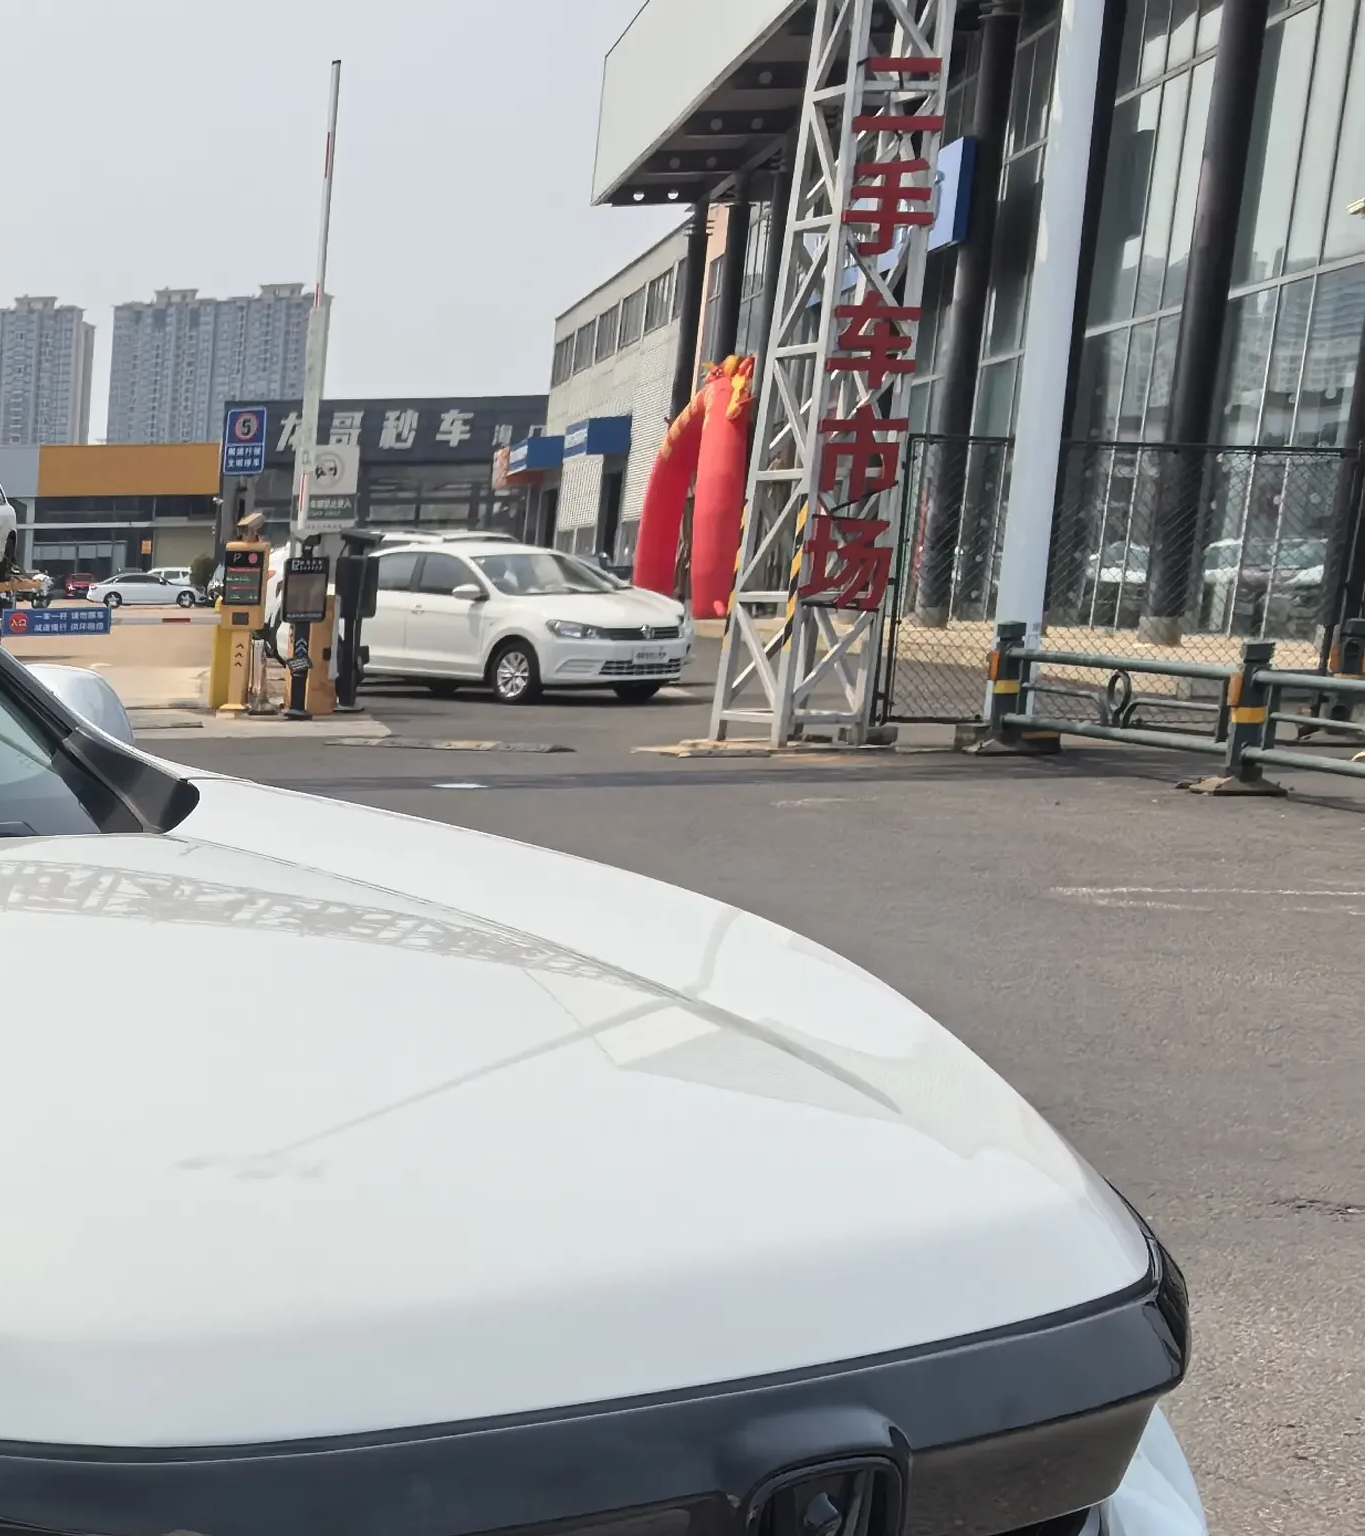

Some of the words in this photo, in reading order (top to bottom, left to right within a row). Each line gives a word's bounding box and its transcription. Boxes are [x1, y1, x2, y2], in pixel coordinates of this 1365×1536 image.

[797, 56, 943, 612] 二手车市场
[242, 417, 251, 436] 5
[11, 618, 27, 627] 入口
